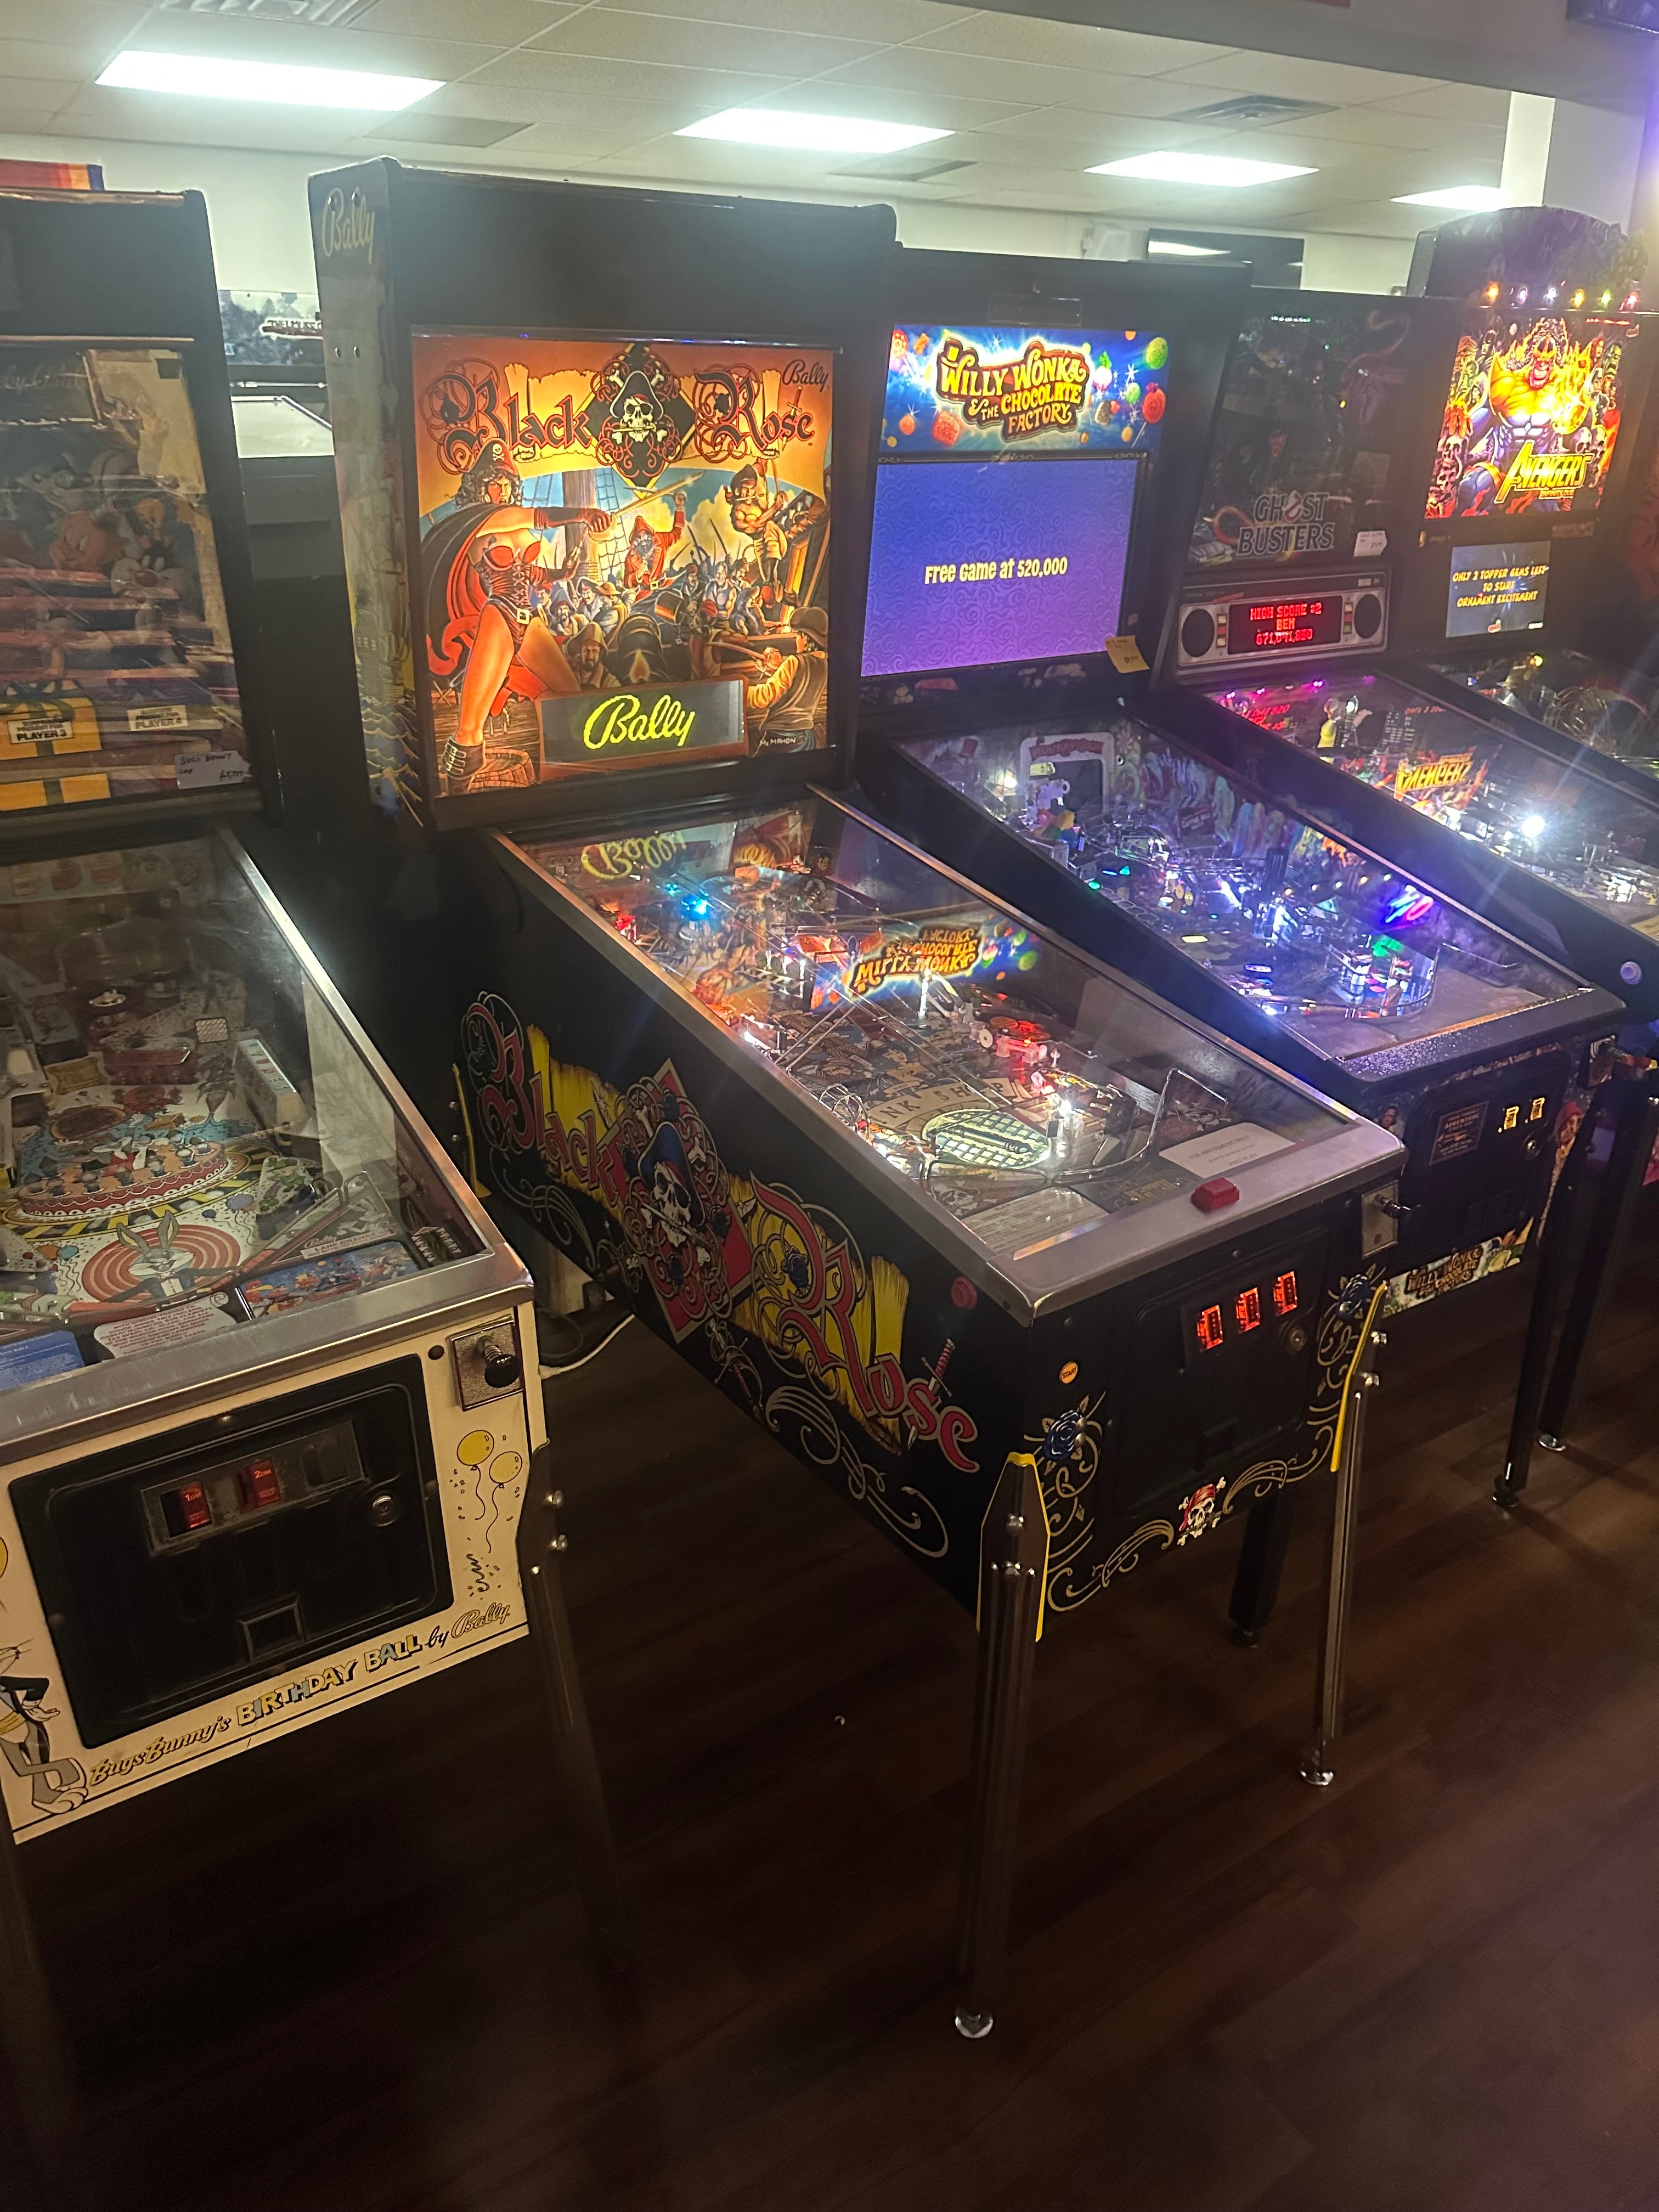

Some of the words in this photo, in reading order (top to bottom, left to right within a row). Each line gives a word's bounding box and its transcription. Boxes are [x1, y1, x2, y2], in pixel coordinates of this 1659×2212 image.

[322, 188, 375, 264] Bally
[783, 358, 829, 394] Bally
[941, 351, 1008, 396] WILLY
[1012, 349, 1087, 391] WONKA
[424, 362, 594, 466] Black
[693, 364, 816, 460] Rose
[968, 399, 989, 416] &
[981, 405, 999, 420] THE
[1001, 382, 1083, 415] CHOCOLATE
[1008, 403, 1073, 433] FACTORY
[1495, 441, 1593, 503] AVENGERS
[1236, 522, 1335, 556] BUSTERS
[924, 564, 956, 584] Free
[1000, 558, 1015, 579] at
[1017, 557, 1068, 578] 520,000
[1452, 571, 1471, 582] ONLY
[1480, 568, 1509, 579] TOPPER
[1510, 566, 1530, 577] GEMS
[1530, 565, 1547, 575] LEFT
[1457, 594, 1496, 607] ORNAMENT
[1496, 590, 1538, 603] EXCITEMENT
[1483, 582, 1493, 592] TO
[1494, 580, 1515, 591] START
[1250, 606, 1274, 620] HIGH
[1277, 603, 1307, 618] SCORE
[1276, 618, 1295, 630] BEN
[16, 730, 59, 741] PLAYER
[135, 718, 174, 729] PLAYER
[583, 694, 696, 750] Bally
[869, 1101, 921, 1124] INK
[934, 1082, 1004, 1101] SHP
[304, 1235, 337, 1249] Bally
[314, 1242, 338, 1252] LANE
[462, 994, 622, 1206] Black
[747, 1171, 979, 1474] Rose
[1063, 1367, 1077, 1379] START
[89, 1750, 146, 1786] Bugs
[145, 1714, 232, 1764] Bunny's
[236, 1658, 359, 1728] BIRTHDAY
[364, 1633, 424, 1673] BALL
[424, 1619, 449, 1648] by
[450, 1602, 511, 1640] Bally
